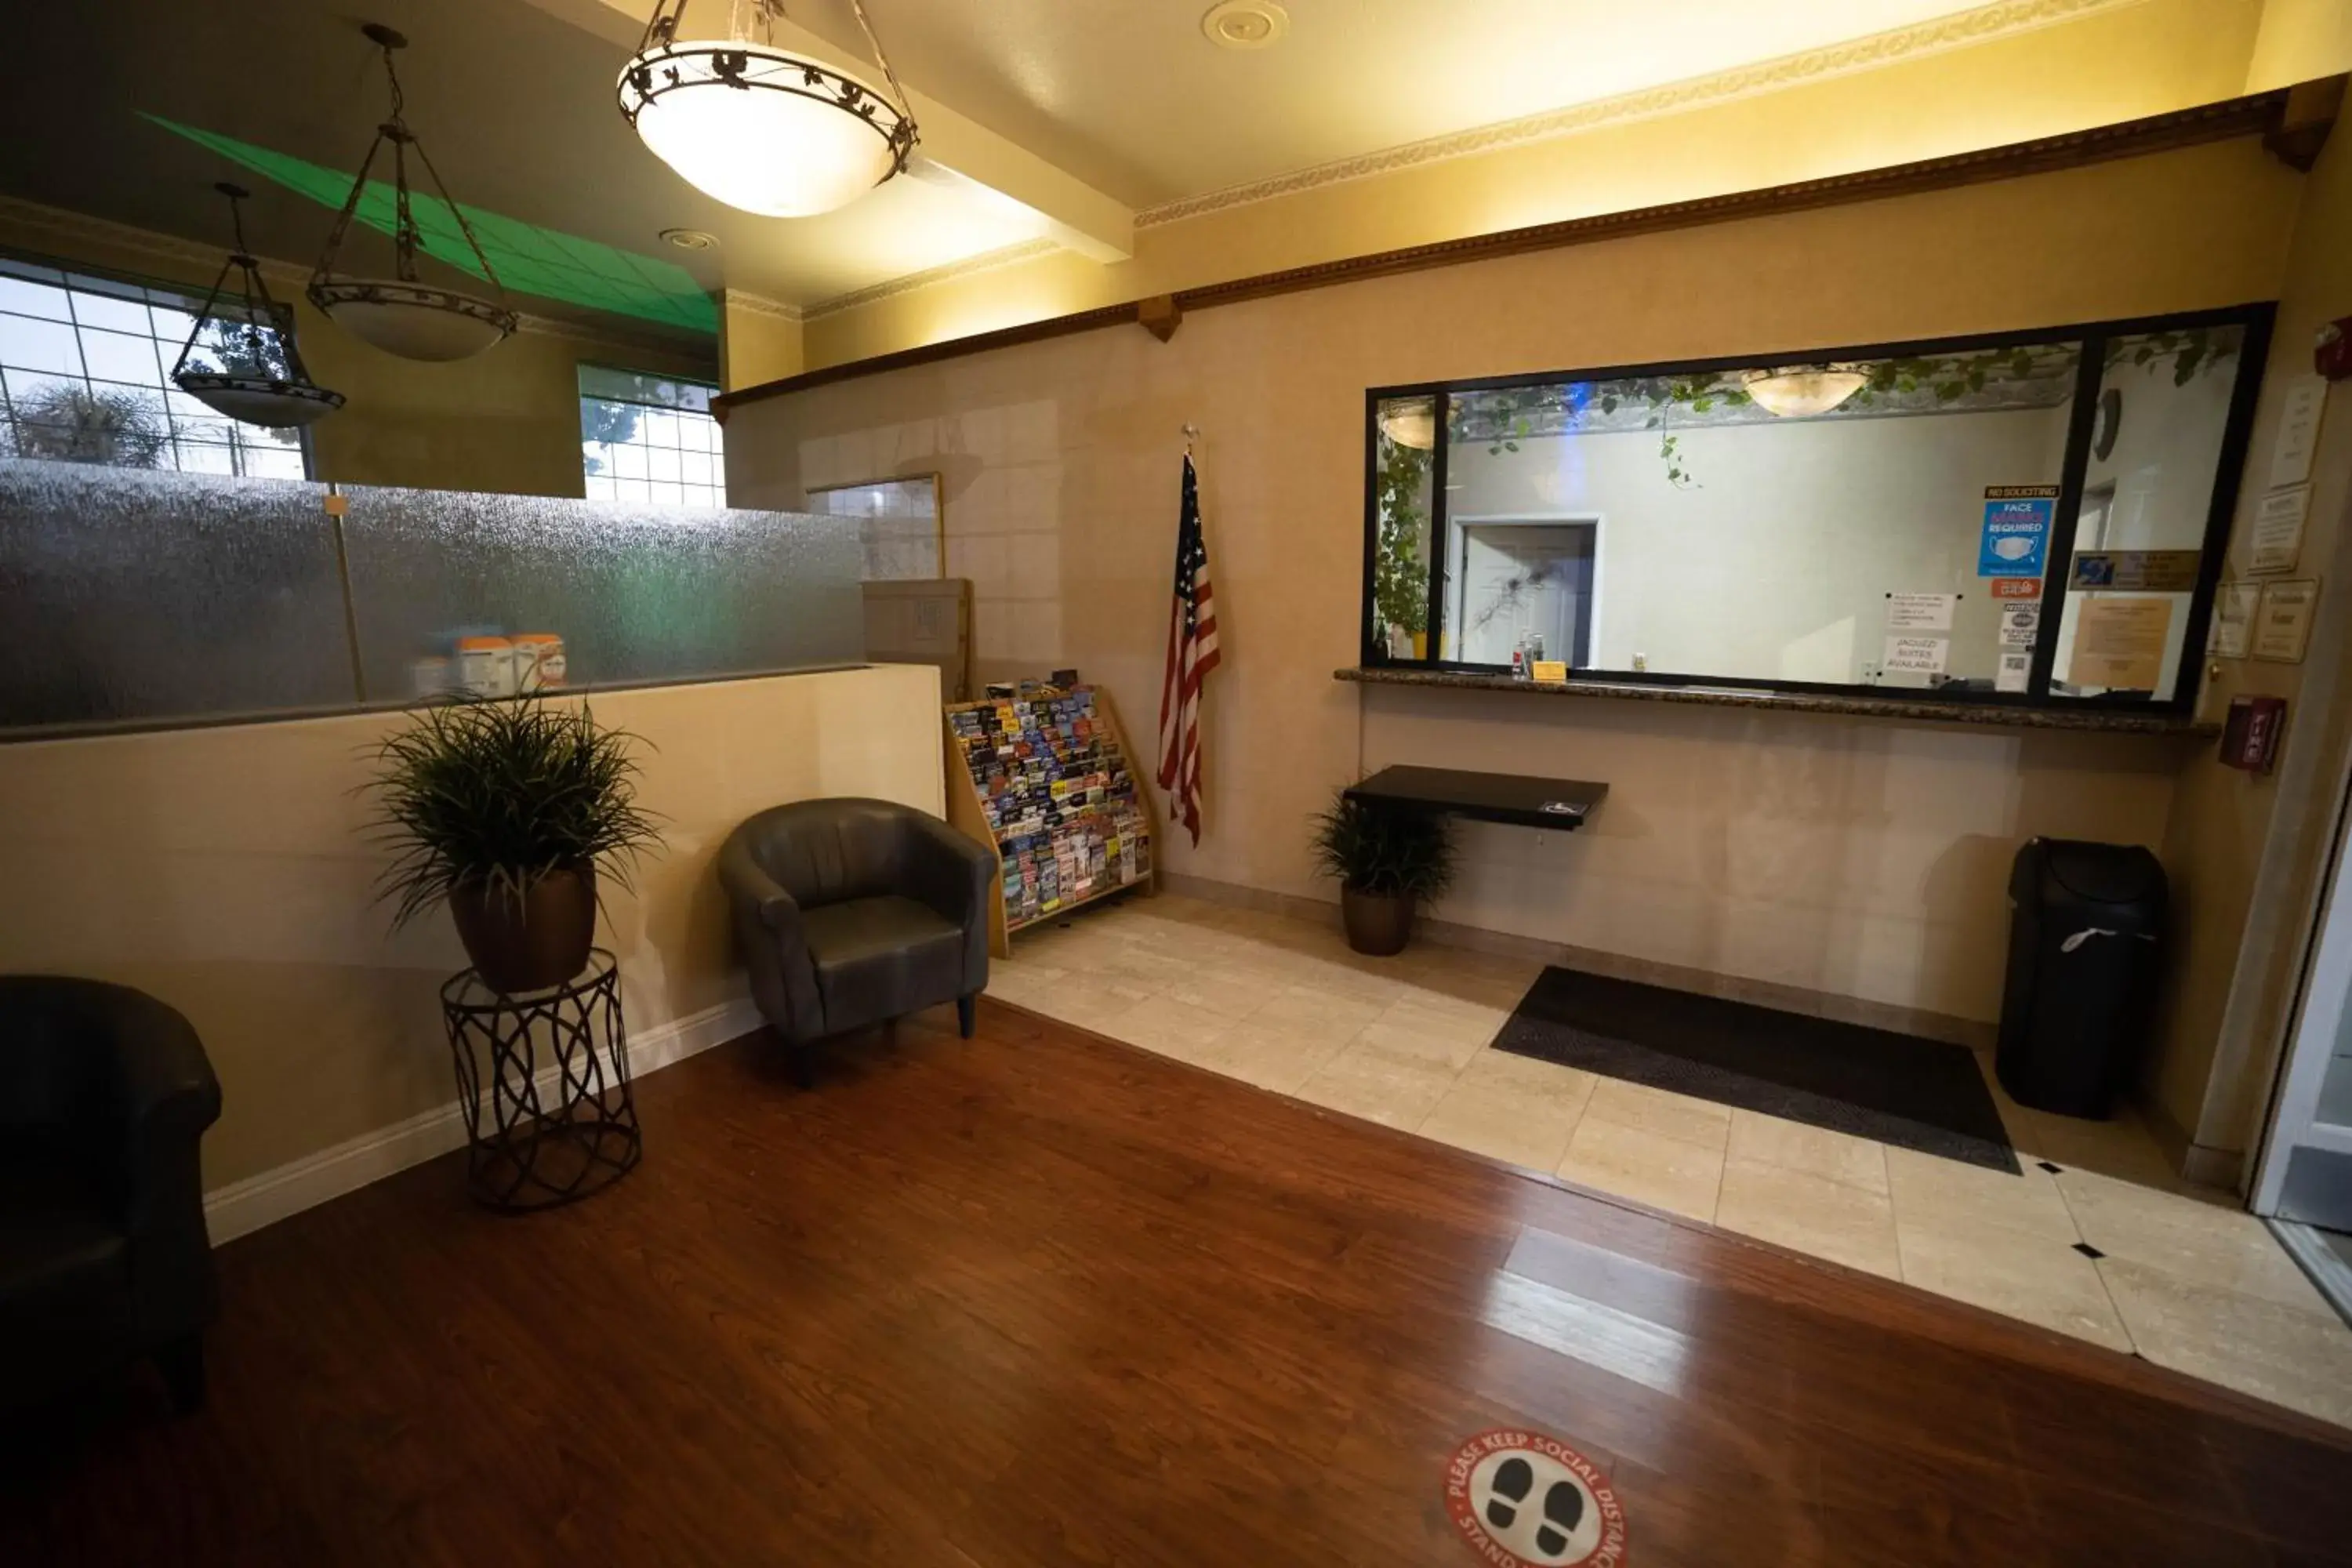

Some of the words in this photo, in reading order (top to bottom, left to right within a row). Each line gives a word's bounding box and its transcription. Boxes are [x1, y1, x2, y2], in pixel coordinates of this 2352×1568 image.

[1988, 488, 2002, 497] NO
[2004, 487, 2057, 497] SOLICITING
[2003, 503, 2033, 512] FACE
[1988, 523, 2043, 532] REQUIRED
[1886, 659, 1940, 670] AVAILABLE
[1448, 1442, 1482, 1497] PLEASE
[1482, 1432, 1529, 1449] KEEP
[1534, 1436, 1600, 1486] SOCIAL
[1458, 1516, 1516, 1568] STAND
